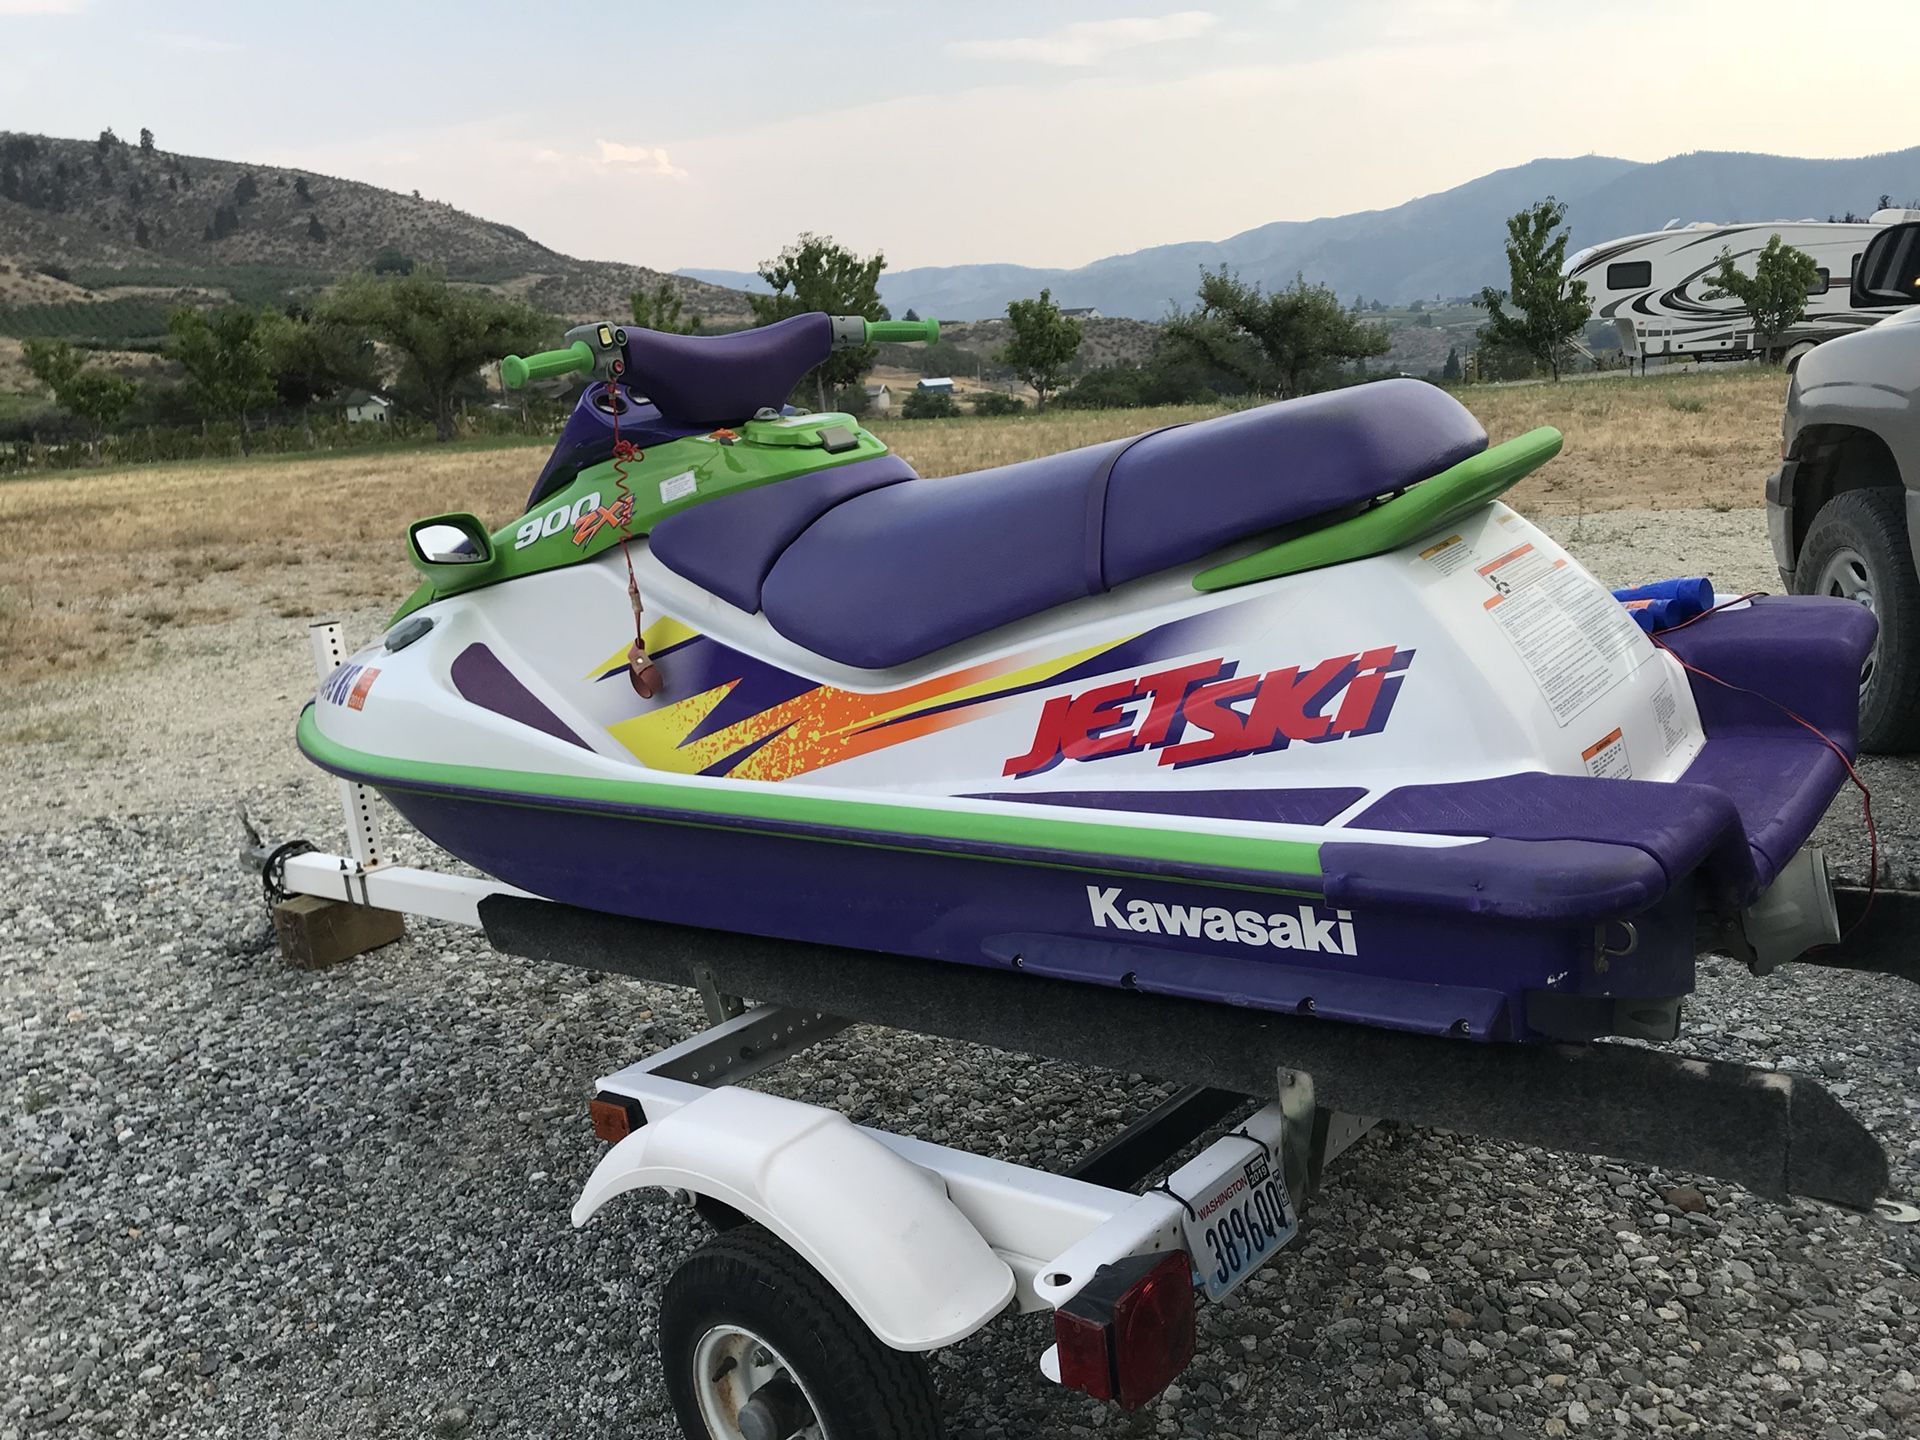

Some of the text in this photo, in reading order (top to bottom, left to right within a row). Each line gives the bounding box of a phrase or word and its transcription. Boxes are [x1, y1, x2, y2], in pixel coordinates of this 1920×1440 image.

[514, 492, 600, 549] 900
[1087, 885, 1357, 956] Kawasaki
[1197, 1176, 1248, 1221] WASHINGTON
[1249, 1165, 1268, 1184] 2019
